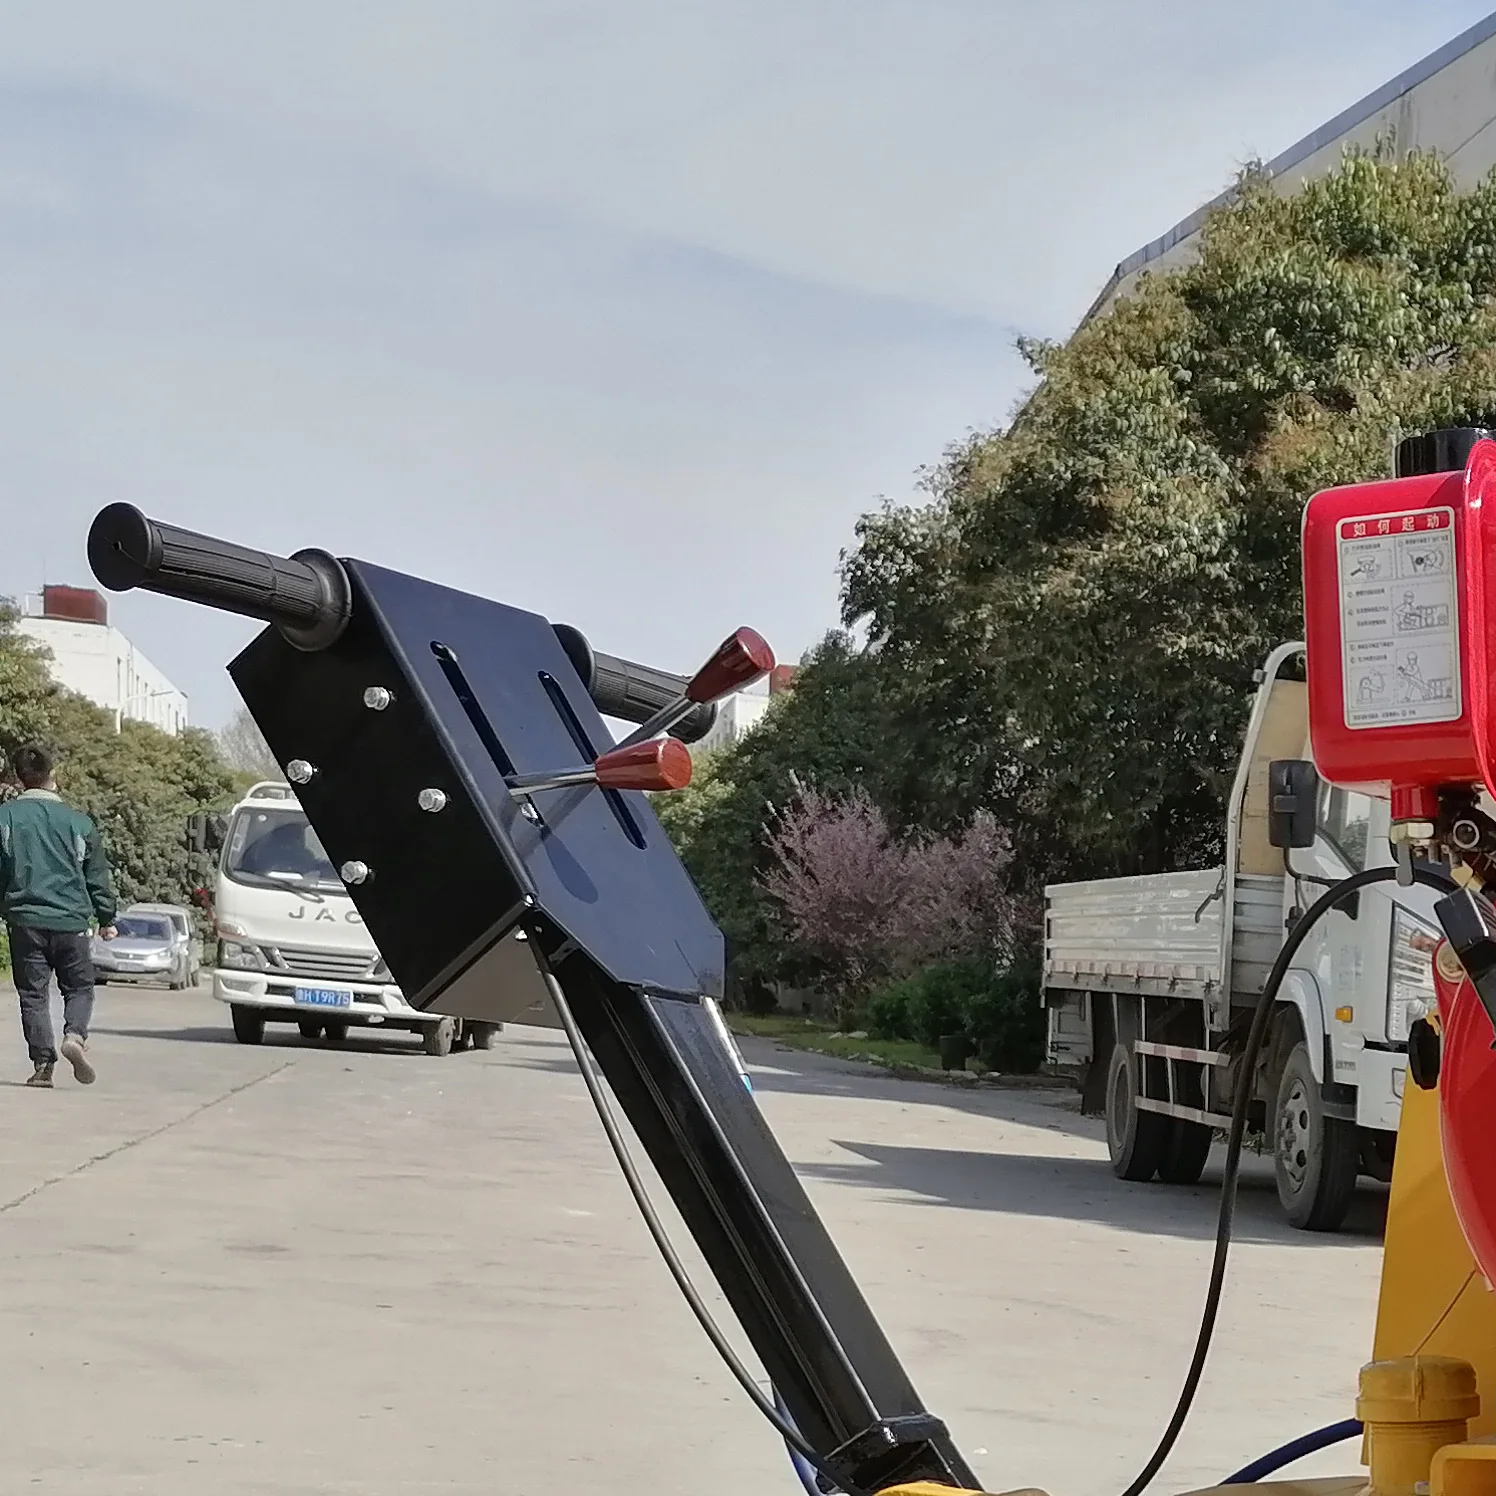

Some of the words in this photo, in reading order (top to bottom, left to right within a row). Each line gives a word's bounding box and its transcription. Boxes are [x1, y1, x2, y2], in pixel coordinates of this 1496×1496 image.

[1354, 513, 1440, 537] 如何起动
[289, 906, 362, 924] JAC
